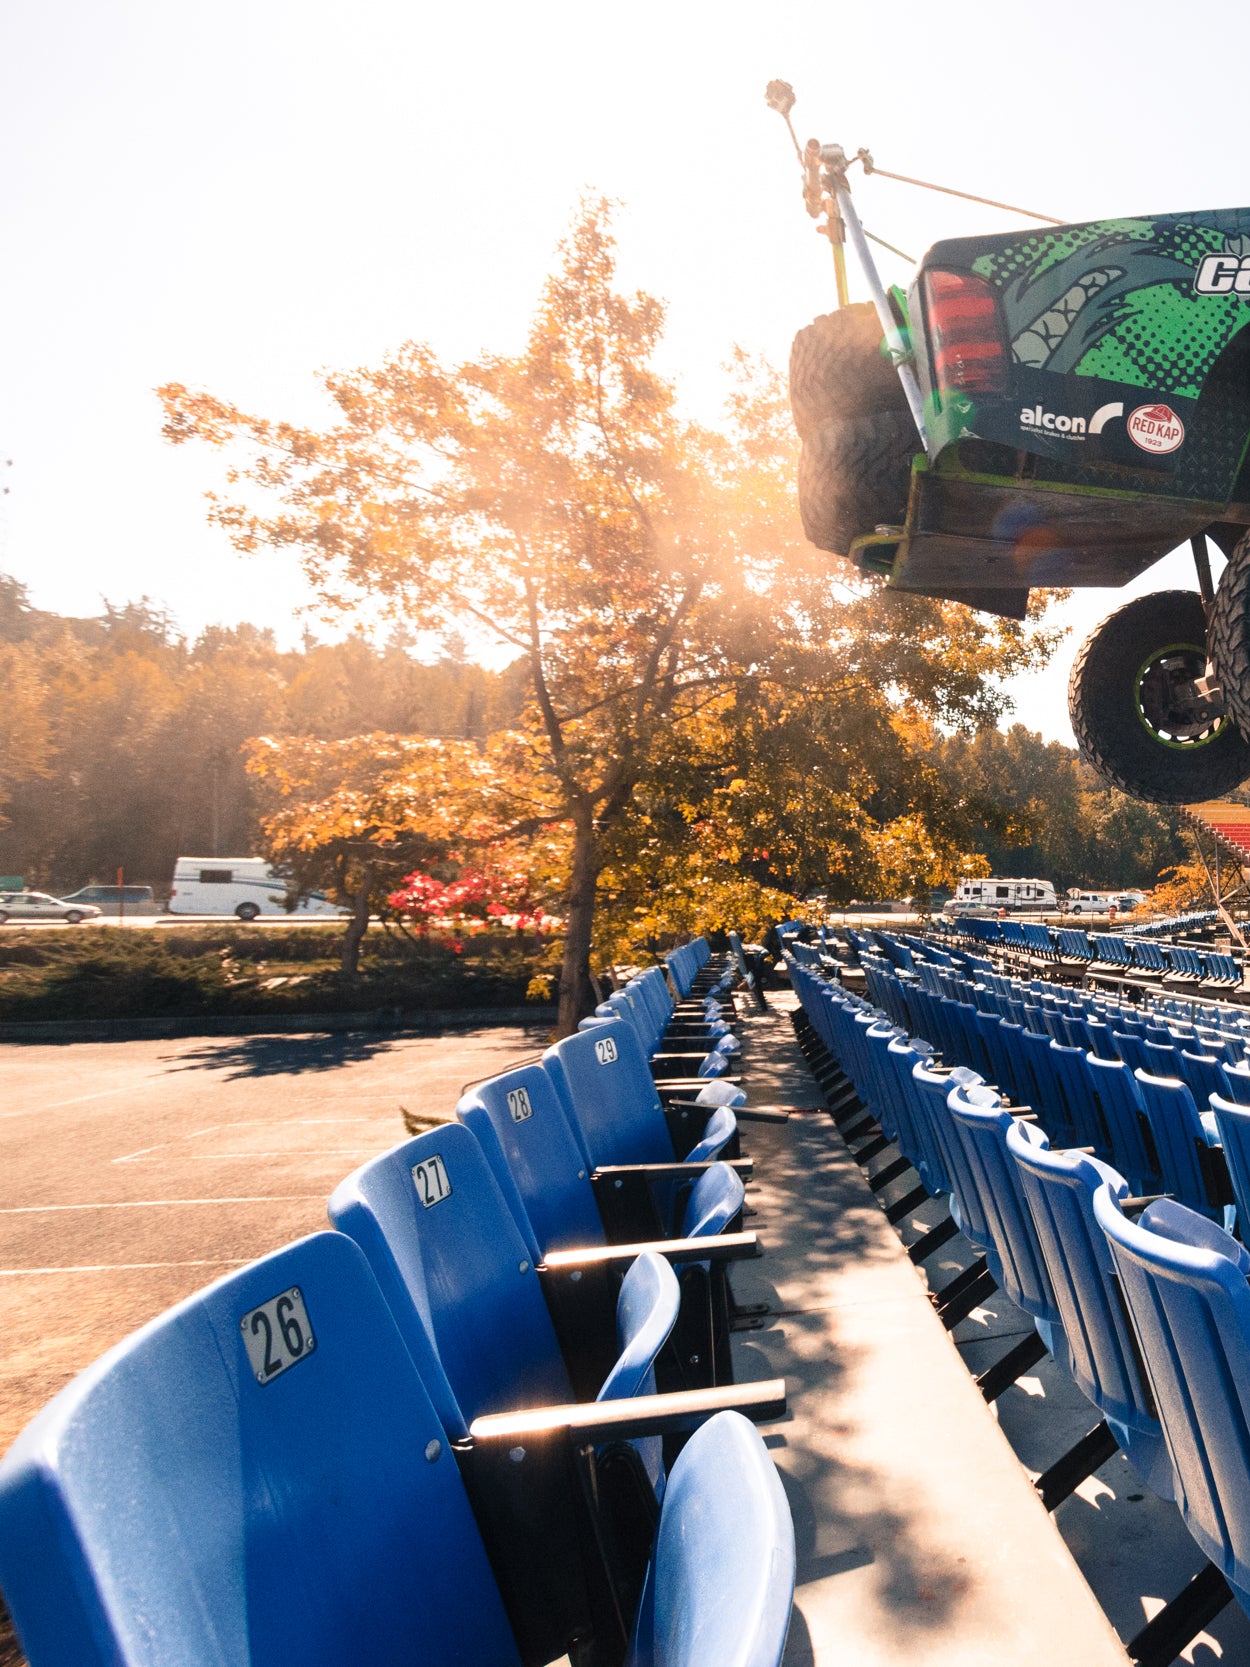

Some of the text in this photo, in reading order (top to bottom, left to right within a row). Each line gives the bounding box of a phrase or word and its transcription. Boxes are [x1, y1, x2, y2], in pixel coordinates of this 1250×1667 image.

[1020, 405, 1087, 434] alcon
[1132, 416, 1180, 441] RED KAP
[1144, 437, 1162, 447] 1923
[598, 1040, 615, 1063] 29
[510, 1090, 528, 1120] 28
[416, 1159, 445, 1205] 27
[251, 1296, 304, 1375] 26
